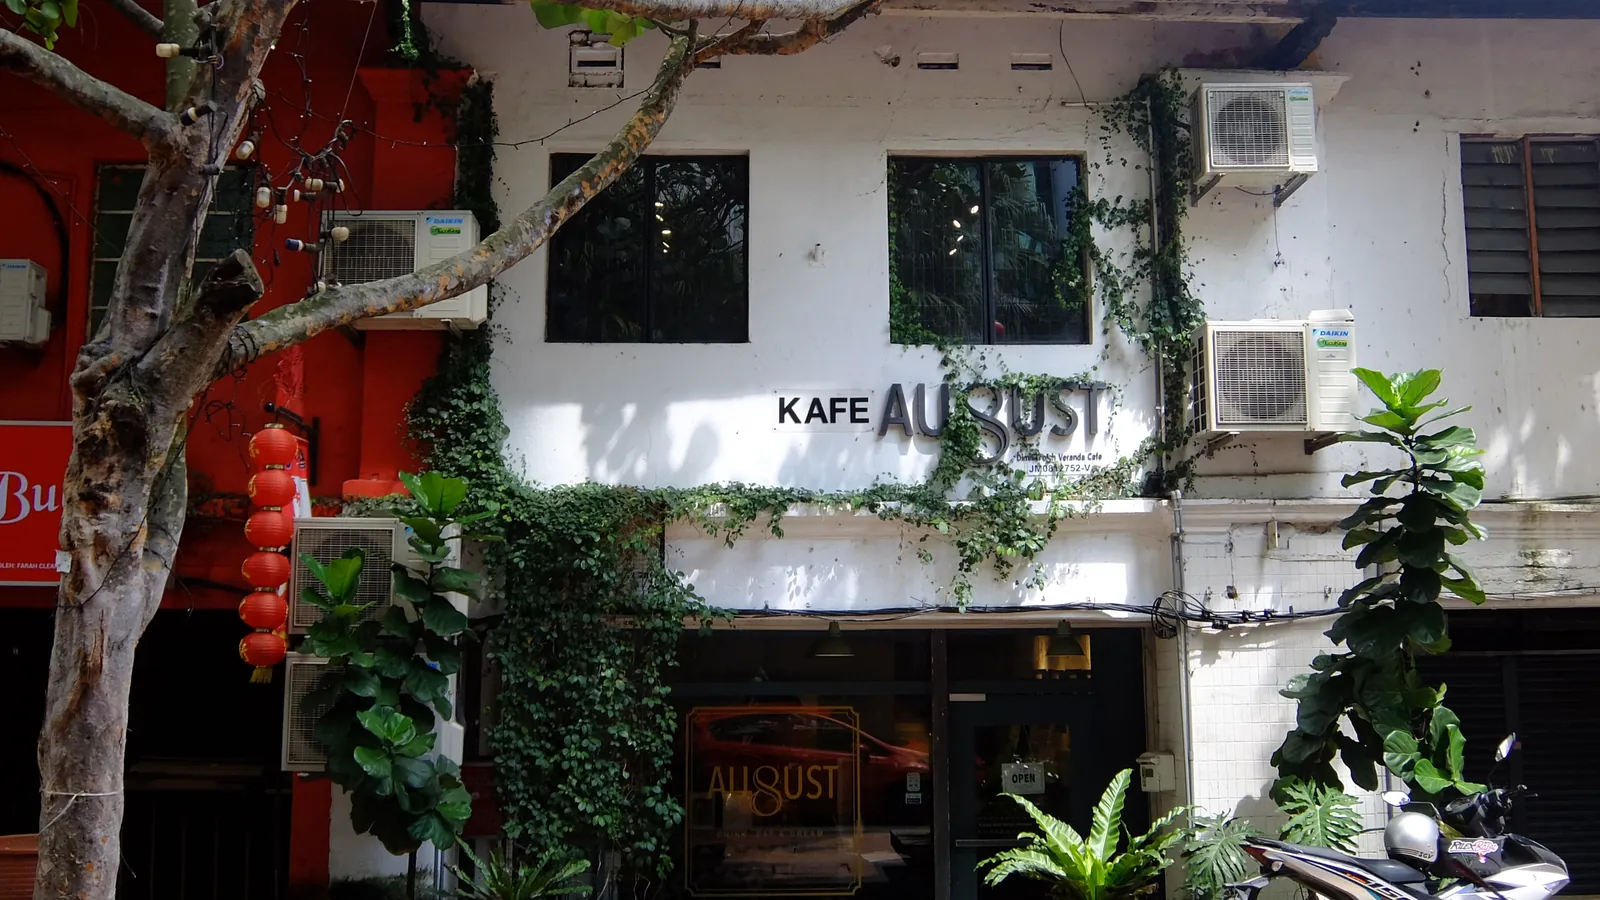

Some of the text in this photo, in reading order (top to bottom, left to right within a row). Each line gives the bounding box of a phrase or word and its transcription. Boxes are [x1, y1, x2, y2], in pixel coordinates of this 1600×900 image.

[779, 397, 869, 424] KAFE
[1058, 453, 1085, 461] Veranda
[1087, 452, 1102, 461] Cafe
[0, 471, 64, 524] Bu
[1012, 772, 1036, 783] OPEN
